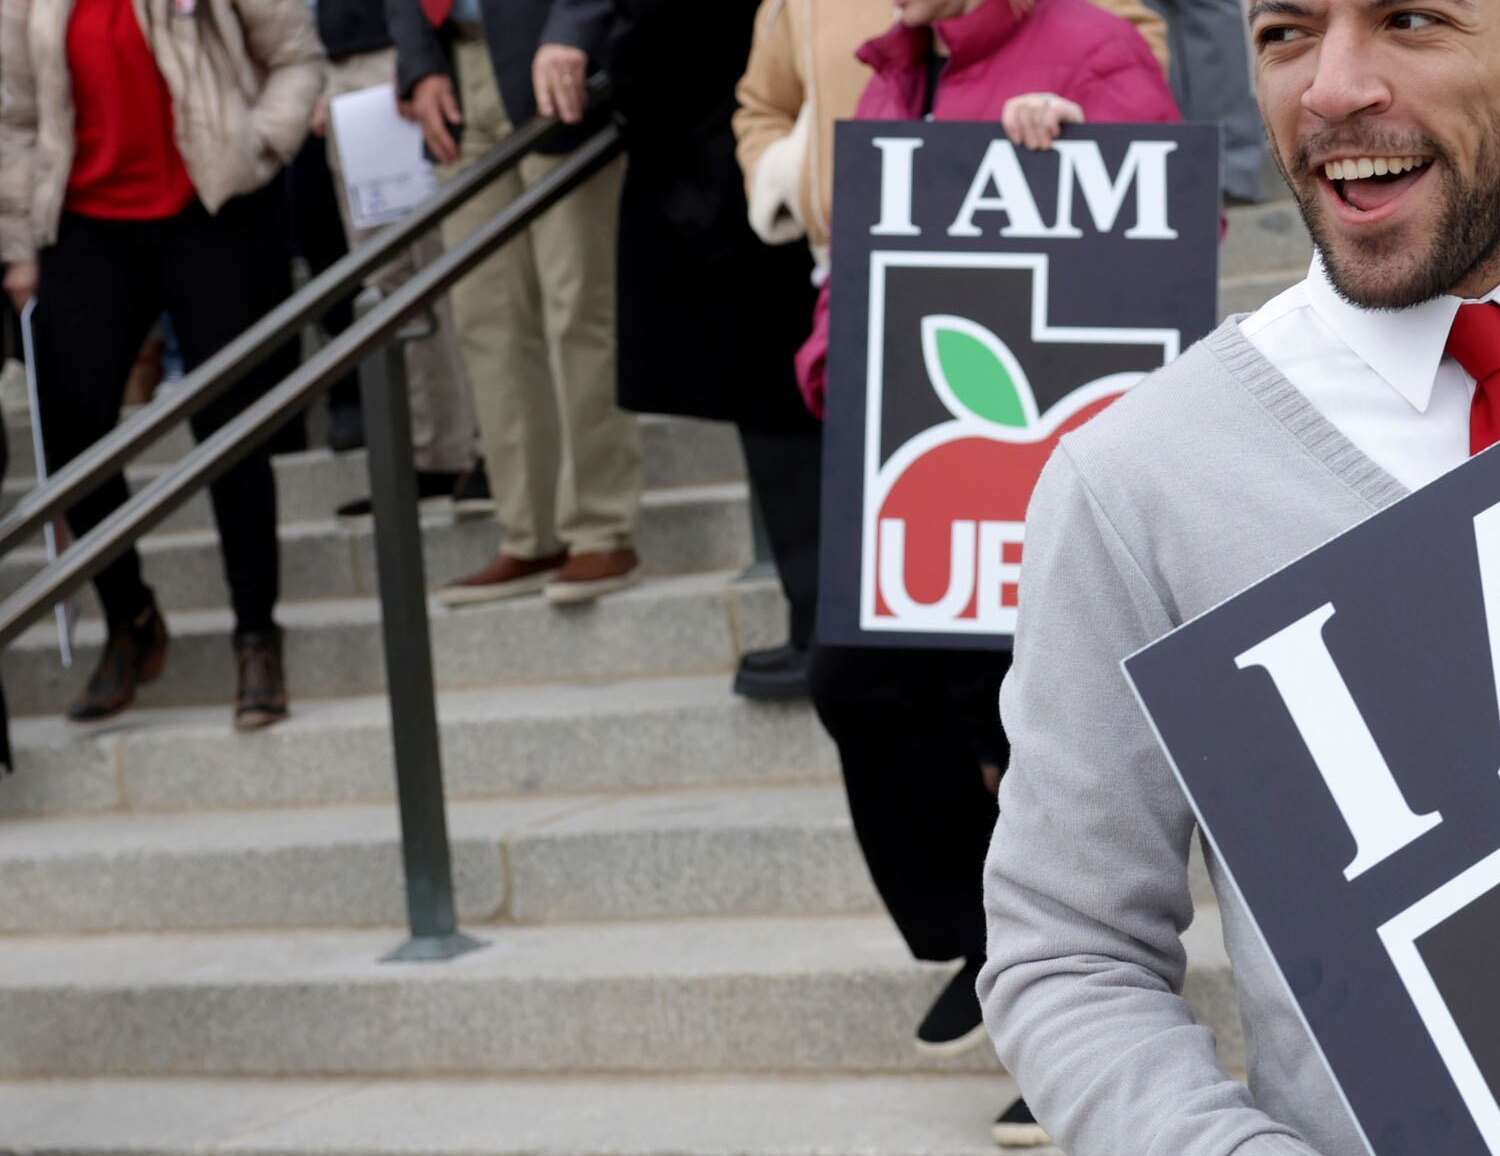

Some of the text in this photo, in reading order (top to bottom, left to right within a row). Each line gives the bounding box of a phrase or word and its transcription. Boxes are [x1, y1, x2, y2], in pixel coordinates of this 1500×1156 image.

[870, 137, 1179, 239] I AM
[878, 518, 1024, 622] UE
[1233, 601, 1443, 882] I
